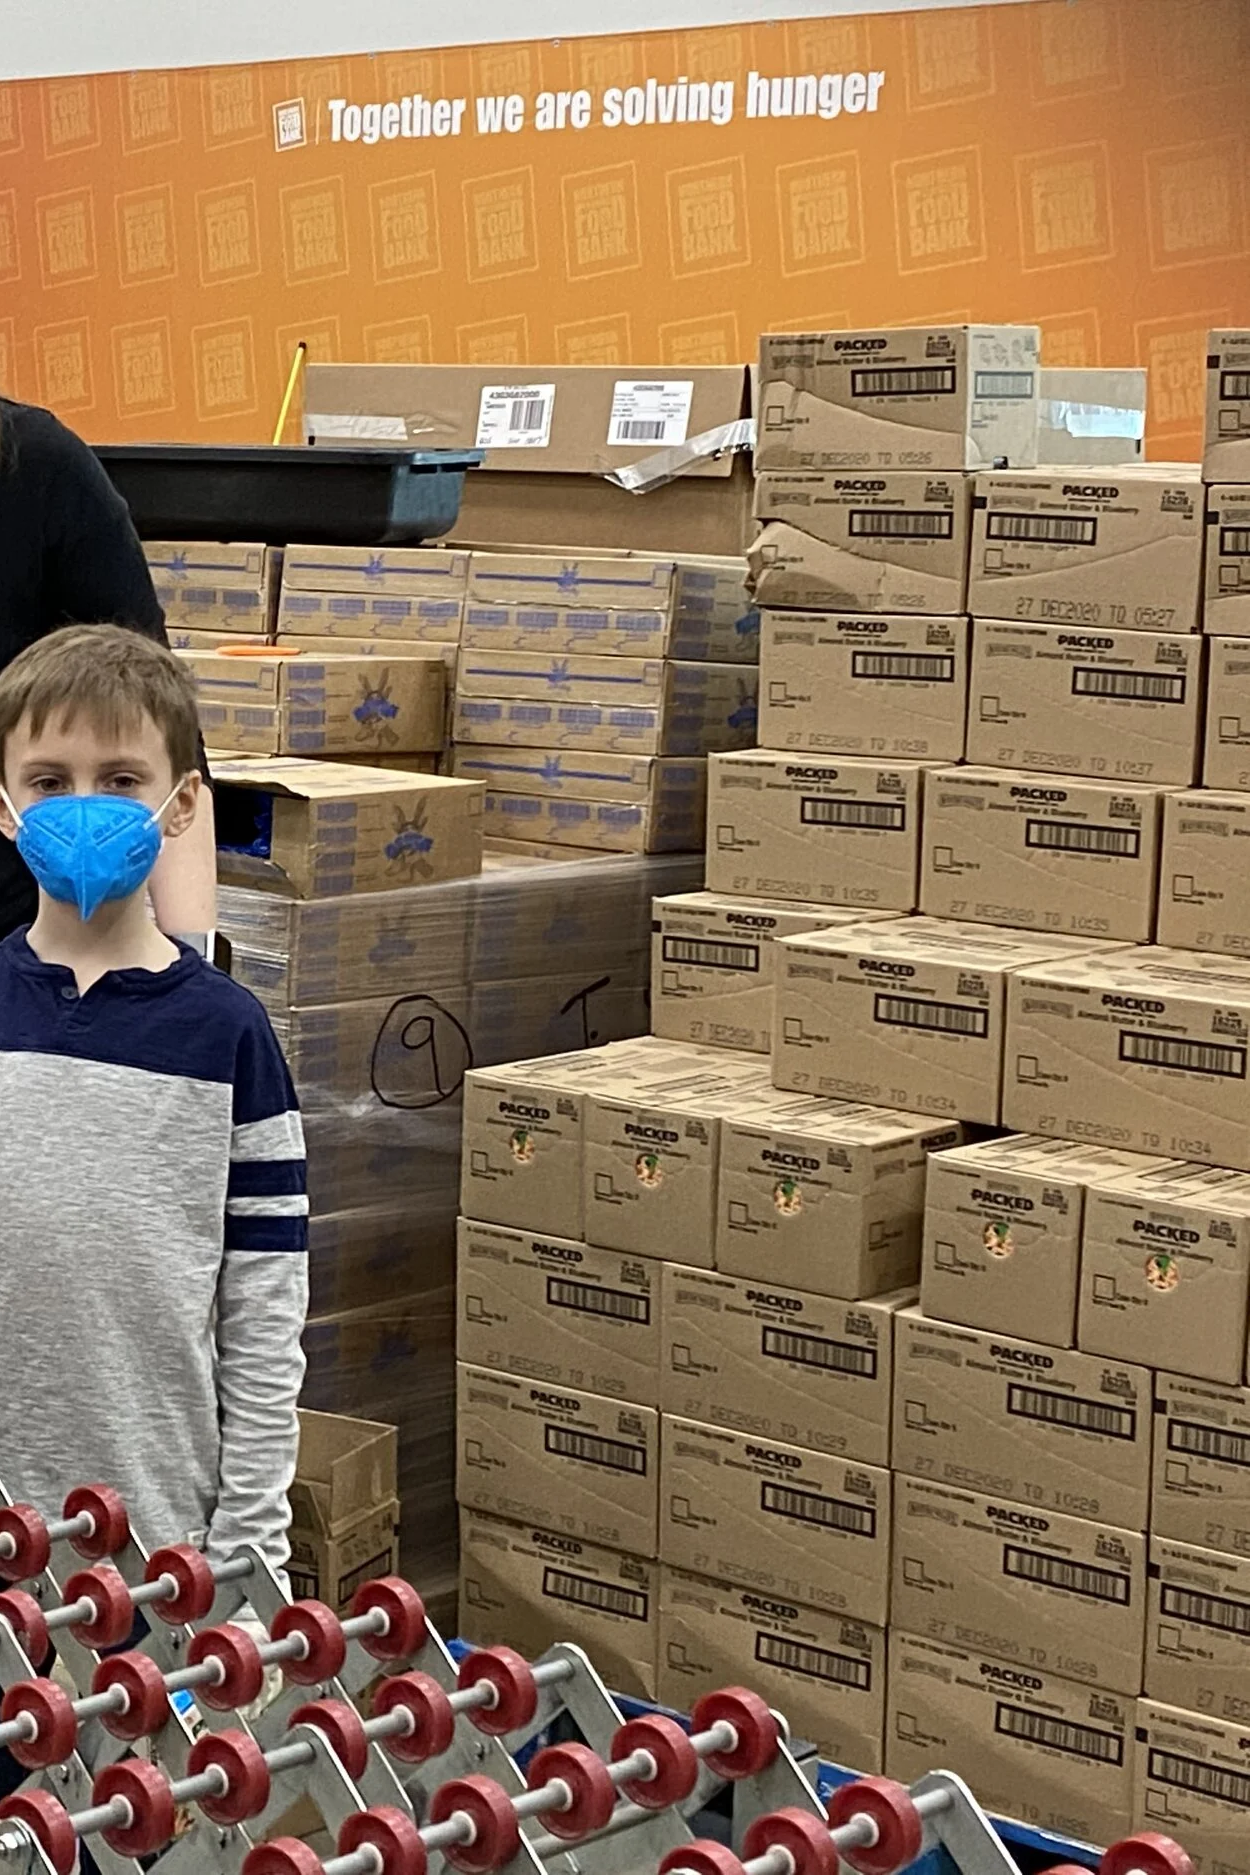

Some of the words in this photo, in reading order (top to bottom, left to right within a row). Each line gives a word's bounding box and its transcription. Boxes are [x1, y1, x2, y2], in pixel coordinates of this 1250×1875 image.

[329, 94, 465, 144] Together
[477, 94, 523, 134] we
[535, 90, 590, 131] are
[602, 76, 734, 126] solving
[746, 70, 884, 120] hunger
[834, 339, 887, 351] PACKED
[834, 480, 886, 491] PACKED
[1063, 485, 1119, 498] PACKED
[1016, 597, 1033, 615] 27
[1041, 598, 1100, 620] DEC2020
[837, 621, 888, 633] PACKED
[1057, 635, 1114, 648] PACKED
[786, 732, 802, 745] 27
[998, 748, 1015, 761] 27
[786, 766, 838, 780] PACKED
[1010, 786, 1067, 802] PACKED
[950, 901, 967, 913] 27
[726, 913, 777, 928] PACKED
[858, 959, 915, 977] PACKED
[1101, 994, 1165, 1014] PACKED
[499, 1102, 551, 1120] PACKED
[1039, 1116, 1057, 1129] 27
[624, 1123, 679, 1142] PACKED
[761, 1150, 820, 1170] PACKED
[971, 1189, 1034, 1211] PACKED
[1133, 1219, 1200, 1244] PACKED
[532, 1243, 583, 1262] PACKED
[746, 1290, 803, 1312] PACKED
[989, 1344, 1053, 1368] PACKED
[530, 1390, 581, 1411] PACKED
[745, 1444, 802, 1468] PACKED
[986, 1506, 1049, 1531] PACKED
[532, 1532, 582, 1554] PACKED
[741, 1595, 798, 1619] PACKED
[980, 1662, 1043, 1690] PACKED
